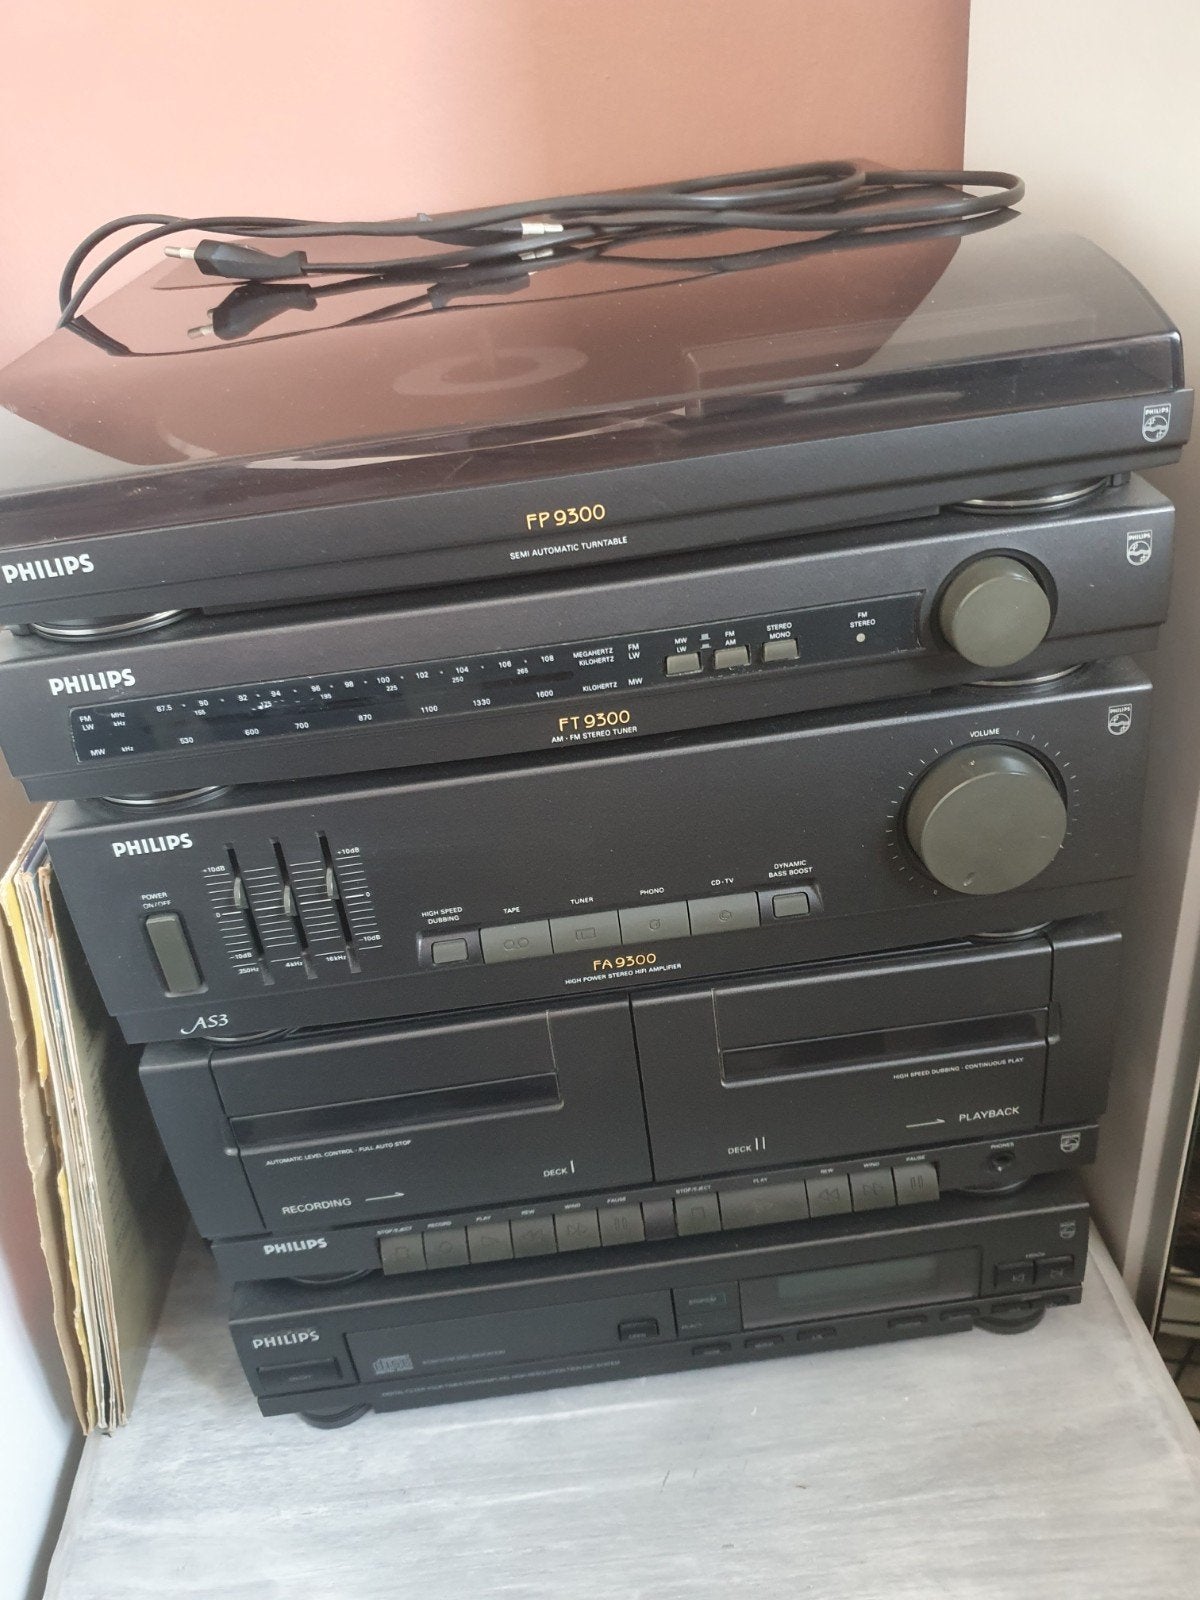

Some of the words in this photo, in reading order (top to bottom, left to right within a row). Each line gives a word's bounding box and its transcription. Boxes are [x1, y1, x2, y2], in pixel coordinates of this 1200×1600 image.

[1145, 407, 1169, 415] PHILIPS
[1128, 532, 1151, 540] PHILIPS
[509, 550, 530, 560] SEMI
[532, 544, 580, 557] AUTOMATIC
[581, 536, 628, 550] TURNTABLE
[1, 554, 94, 583] PHILIPS
[857, 611, 868, 619] FM
[766, 622, 792, 632] STEREO
[849, 619, 876, 628] STEREO
[724, 630, 735, 638] FM
[769, 631, 791, 640] MONO
[674, 637, 688, 645] MW
[48, 668, 136, 695] PHILIPS
[156, 704, 173, 713] 87.5
[237, 694, 248, 702] 92
[270, 690, 282, 698] 94
[310, 684, 321, 692] 96
[376, 676, 391, 684] 100
[416, 671, 429, 679] 102
[455, 666, 469, 674] 104
[498, 660, 512, 669] 106
[540, 655, 555, 663] 108
[573, 647, 614, 659] MEGAHERTZ
[627, 643, 640, 651] FM
[82, 724, 95, 732] LW
[386, 684, 398, 692] 225
[452, 676, 464, 684] 250
[578, 656, 615, 666] KILOHERTZ
[628, 652, 640, 660] LW
[79, 715, 92, 723] FM
[90, 749, 106, 757] MW
[294, 721, 310, 730] 700
[358, 714, 373, 722] 870
[421, 705, 439, 714] 1100
[472, 698, 491, 707] 1330
[536, 690, 554, 699] 1600
[582, 681, 618, 692] KILOHERTZ
[628, 677, 643, 686] MW
[551, 736, 564, 744] AM
[569, 733, 581, 741] FM
[582, 730, 611, 740] STEREO
[612, 726, 638, 736] TUNER
[969, 728, 1000, 738] VOLUME
[111, 832, 194, 858] PHILIPS
[336, 846, 360, 855] +10dB
[203, 865, 226, 874] +10dB
[773, 859, 807, 870] DYNAMIC
[768, 869, 788, 879] BASS
[789, 866, 814, 876] BOOST
[141, 891, 168, 902] POWER
[639, 886, 665, 896] PHONO
[142, 900, 172, 910] ON/OFF
[570, 896, 595, 905] TUNER
[421, 909, 439, 918] HIGH
[440, 906, 463, 915] SPEED
[503, 906, 521, 915] TAPE
[427, 914, 460, 925] DUBBING
[583, 974, 607, 983] POWER
[608, 970, 634, 979] STEREO
[648, 963, 682, 973] AMPLIFIER
[180, 1013, 229, 1035] AS3
[893, 1072, 909, 1080] HIGH
[910, 1069, 930, 1078] SPEED
[931, 1065, 960, 1075] DUBBING
[964, 1058, 1007, 1070] CONTINUOUS
[1008, 1056, 1024, 1065] PLAY
[958, 1106, 1020, 1123] PLAYBACK
[265, 1155, 303, 1167] AUTOMATIC
[305, 1152, 323, 1161] LEVEL
[324, 1148, 354, 1158] CONTROL
[375, 1142, 394, 1150] AUTO
[394, 1139, 412, 1148] STOP
[727, 1144, 753, 1155] DECK
[543, 1166, 568, 1178] DECK
[281, 1197, 352, 1215] RECORDING
[263, 1237, 328, 1255] PHILIPS
[252, 1330, 320, 1350] PHILIPS
